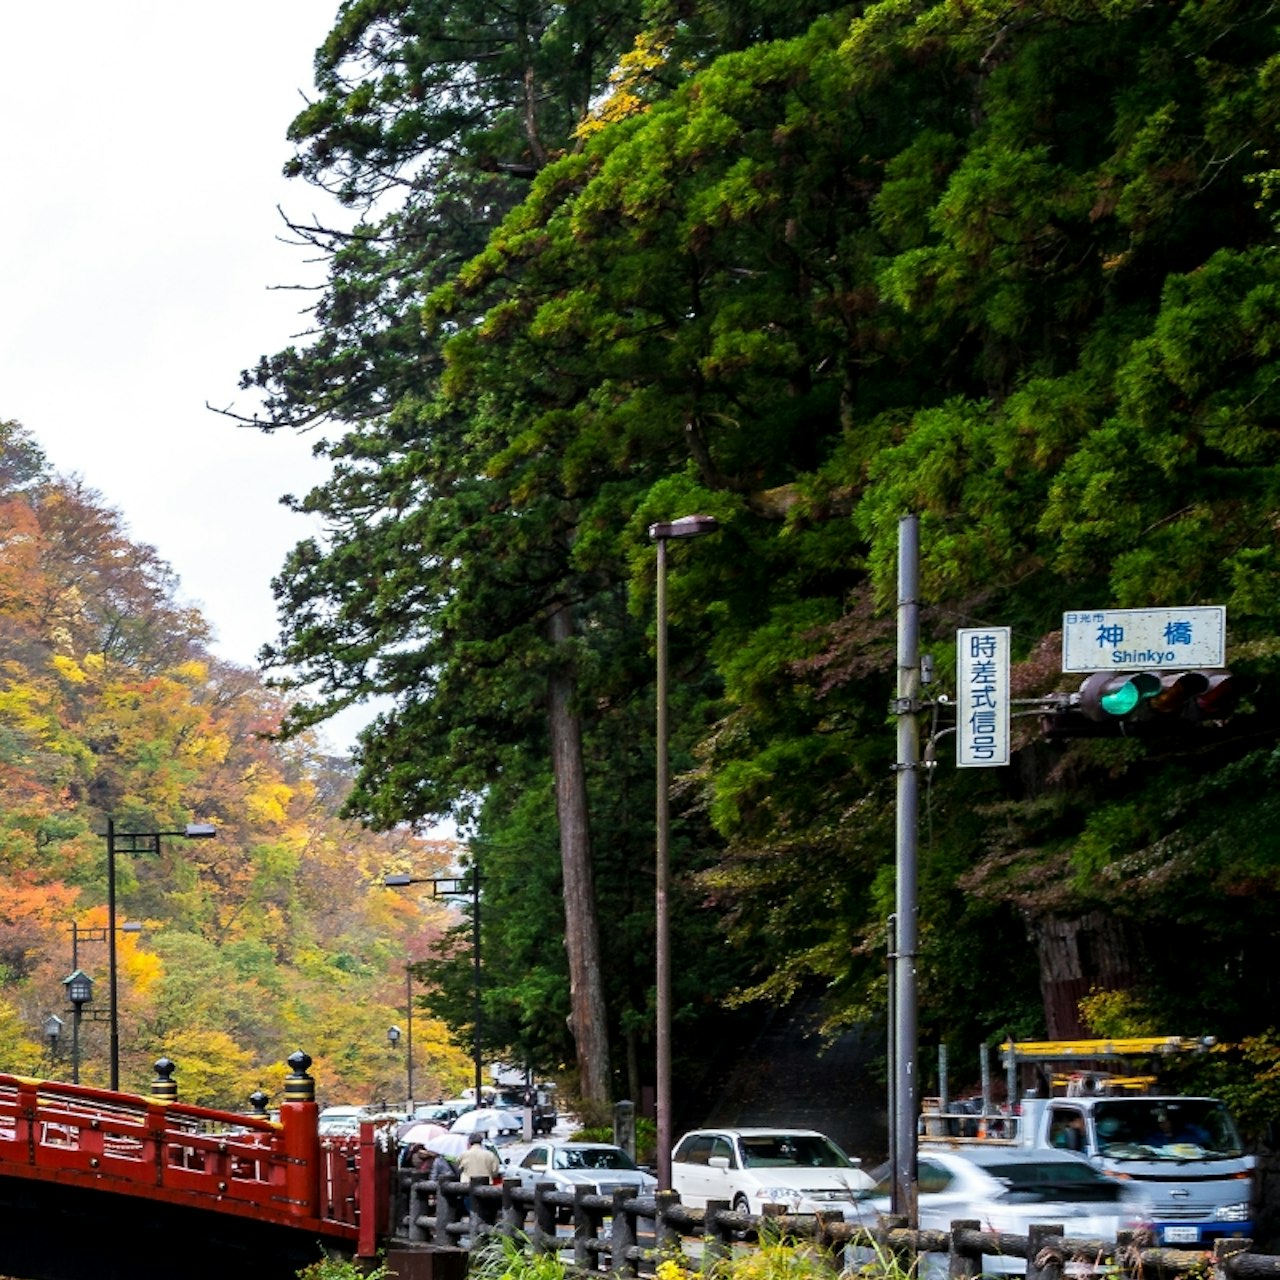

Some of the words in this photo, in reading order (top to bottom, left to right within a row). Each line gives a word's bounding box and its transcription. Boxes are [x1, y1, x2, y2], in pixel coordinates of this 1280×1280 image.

[1067, 613, 1104, 624] 日光市
[1112, 650, 1175, 664] Shinkyo
[969, 635, 997, 759] 時差式信号
